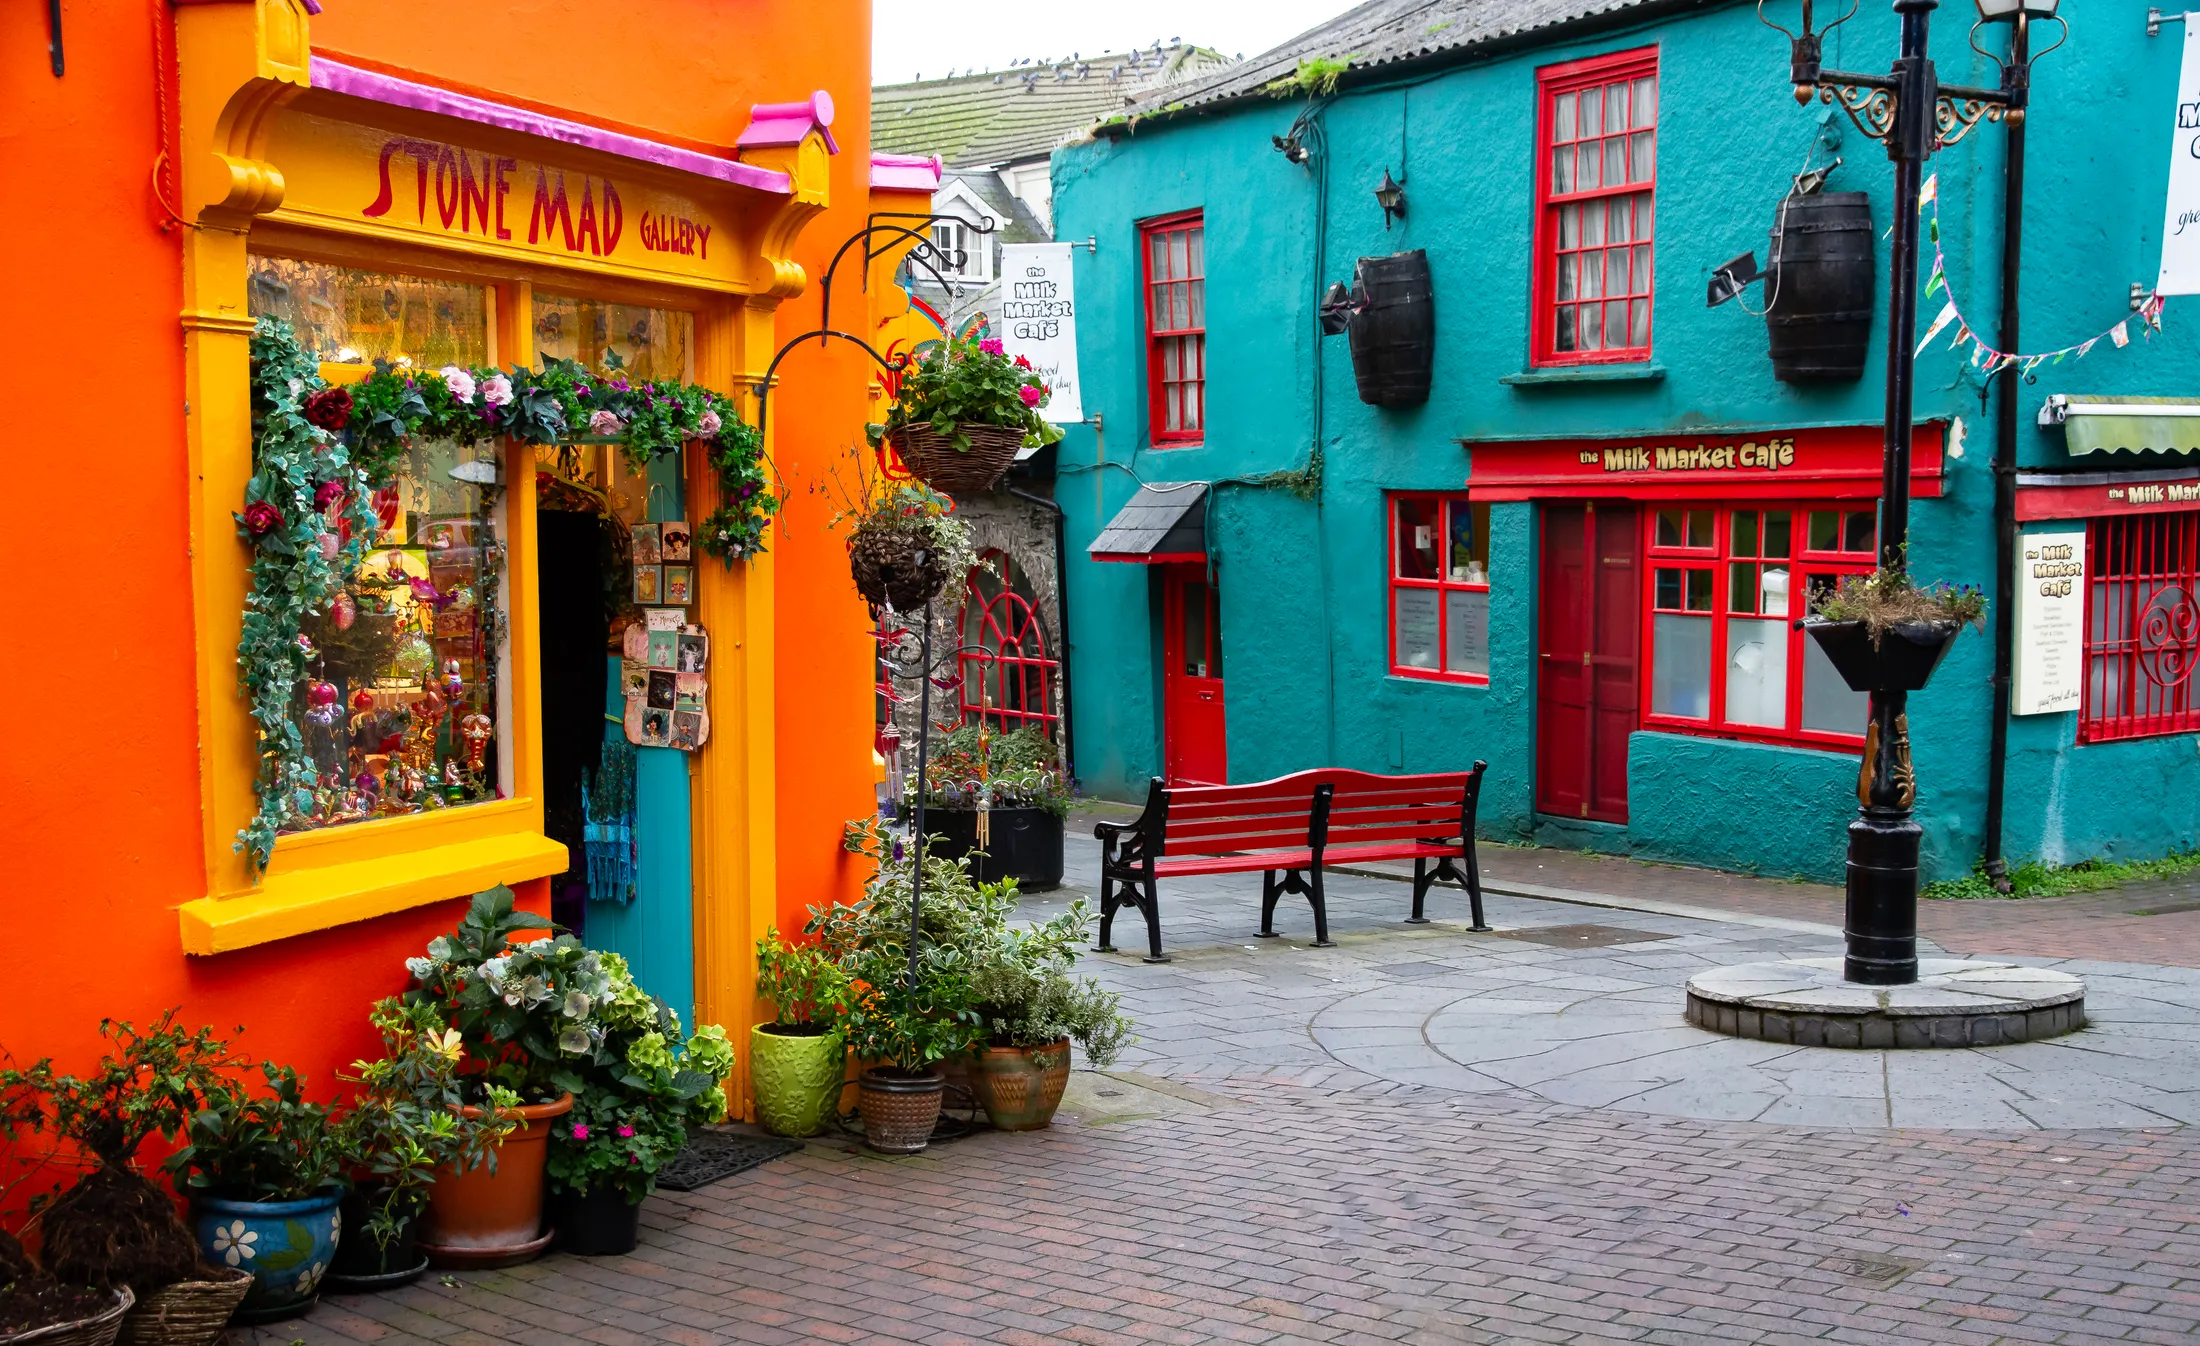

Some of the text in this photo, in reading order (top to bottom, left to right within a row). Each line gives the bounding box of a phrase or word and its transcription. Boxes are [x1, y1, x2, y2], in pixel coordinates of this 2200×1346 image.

[362, 137, 712, 260] STONE MAD GALLERY
[2173, 209, 2200, 236] gre
[1026, 266, 1046, 278] the
[1014, 281, 1057, 300] Milk
[1003, 301, 1073, 319] Market
[1014, 320, 1059, 341] Café
[1056, 376, 1072, 395] day
[1579, 437, 1796, 472] the Milk Market Café
[2108, 488, 2125, 499] the
[2127, 484, 2165, 504] Milk
[2042, 544, 2073, 561] Milk
[2033, 562, 2083, 578] Market
[2040, 579, 2072, 598] Café
